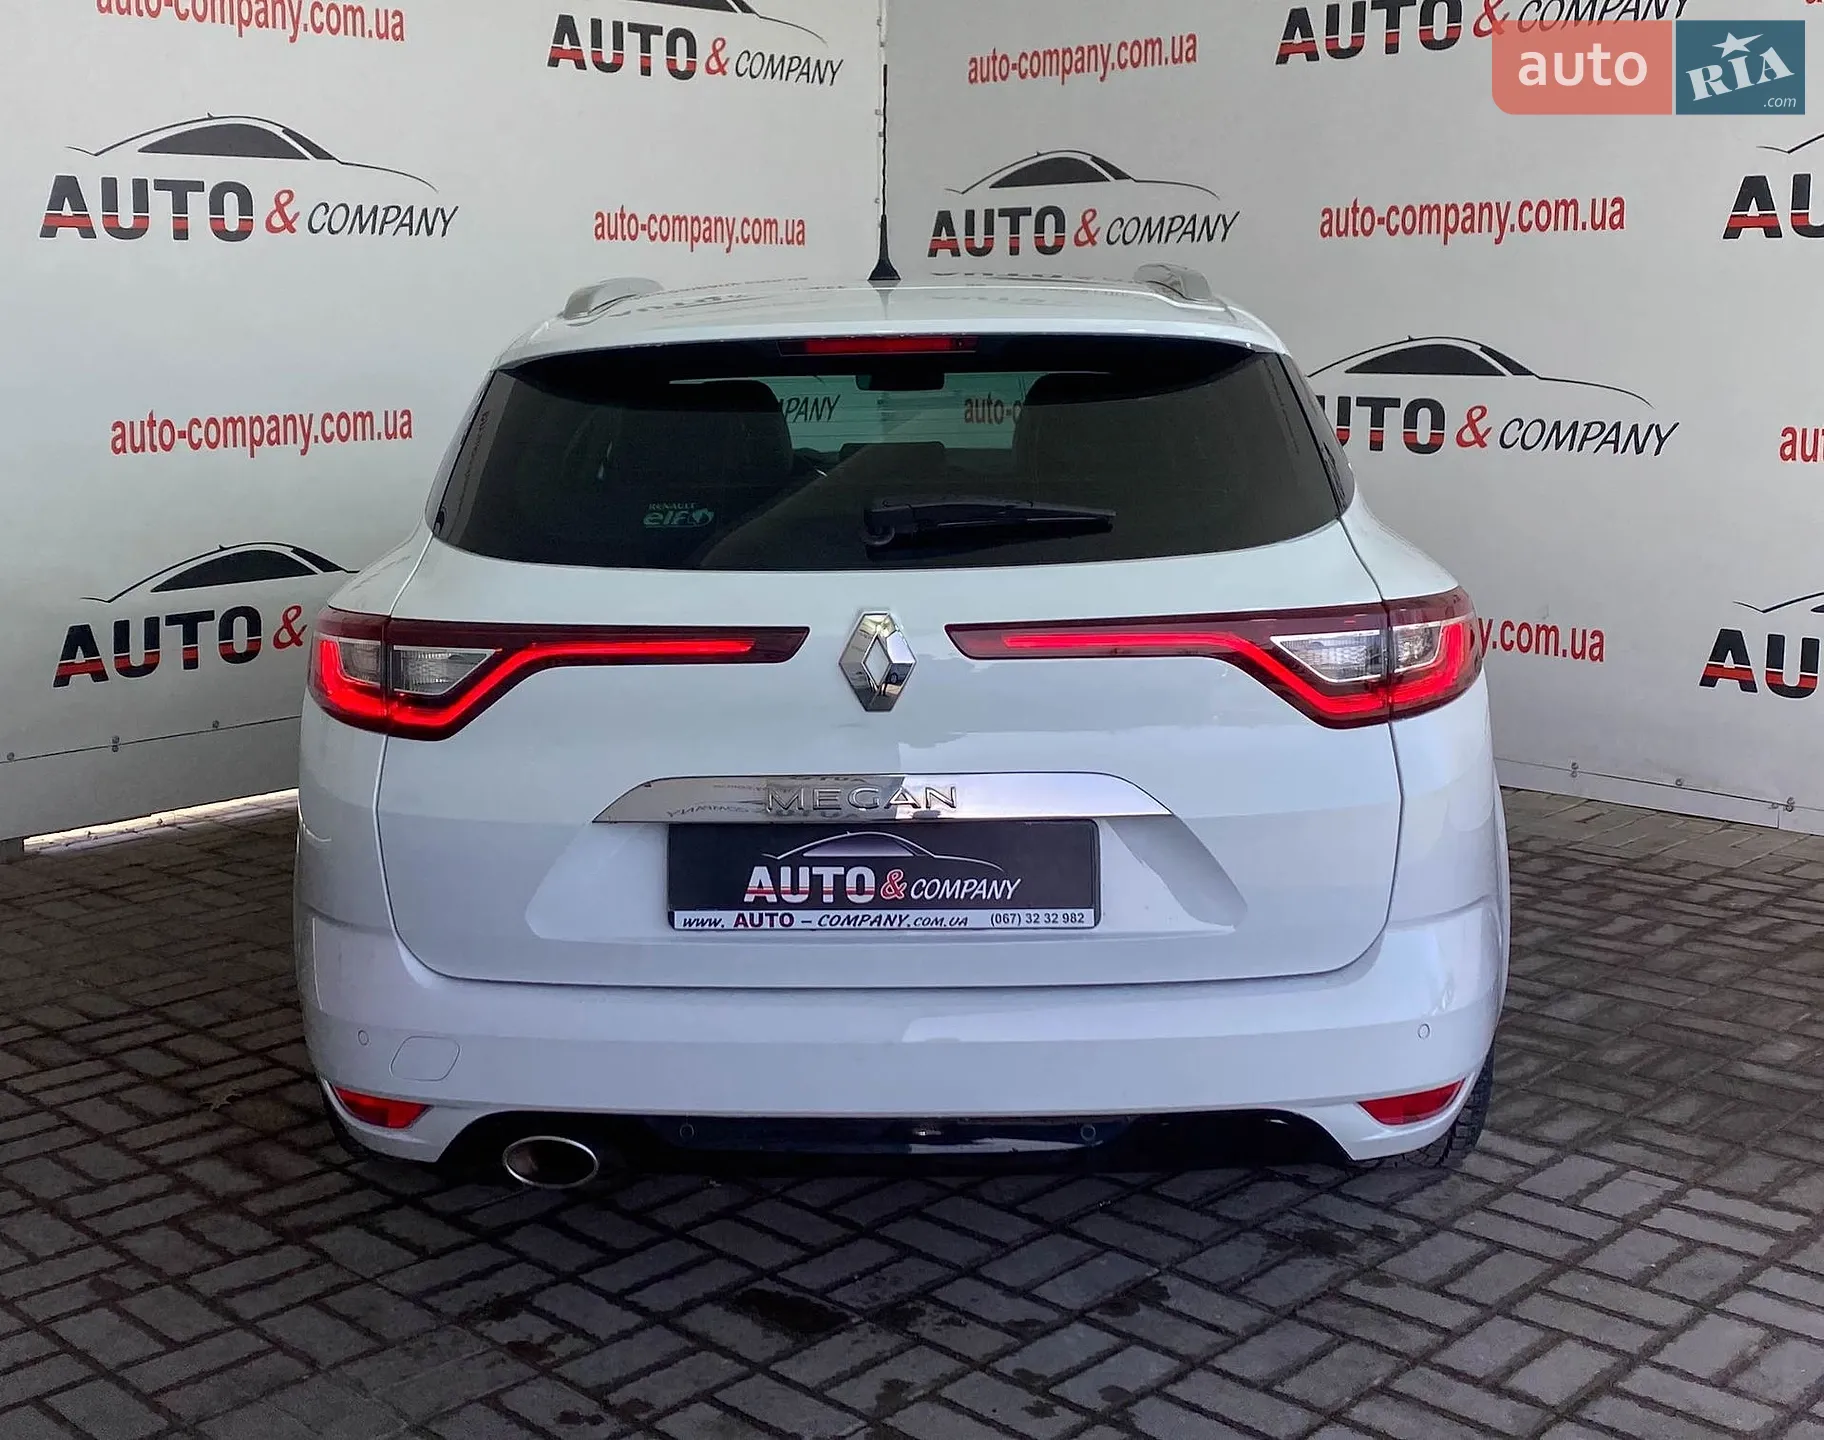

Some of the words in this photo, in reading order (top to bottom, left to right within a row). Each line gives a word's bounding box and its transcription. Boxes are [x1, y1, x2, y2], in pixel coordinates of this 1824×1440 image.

[547, 14, 697, 80] AUTO
[704, 37, 730, 76] &
[735, 50, 844, 86] COMPANY
[1275, 0, 1462, 64] AUTO
[1472, 0, 1511, 38] &
[968, 33, 1198, 85] auto-company.com.ua
[39, 175, 256, 242] AUTO
[265, 189, 300, 235] &
[307, 202, 459, 237] COMPANY
[594, 206, 807, 253] auto-company.com.ua
[927, 205, 1066, 257] AUTO
[1073, 207, 1100, 248] &
[1105, 211, 1241, 246] COMPANY
[1319, 196, 1627, 245] auto-company.com.ua
[111, 408, 413, 458] auto-company.com.ua
[780, 394, 841, 423] PANY
[1455, 404, 1493, 449] &
[1499, 417, 1680, 456] COMPANY
[1779, 426, 1824, 464] au
[53, 605, 262, 688] AUTO
[273, 605, 308, 649] &
[766, 785, 958, 811] MEGAN
[743, 866, 876, 904] AUTO
[880, 868, 907, 900] &
[910, 877, 1022, 900] COMPANY
[733, 912, 795, 928] AUTO
[990, 912, 1022, 926] (067)
[1025, 912, 1041, 925] 32
[1044, 912, 1059, 925] 32
[1062, 912, 1085, 925] 982
